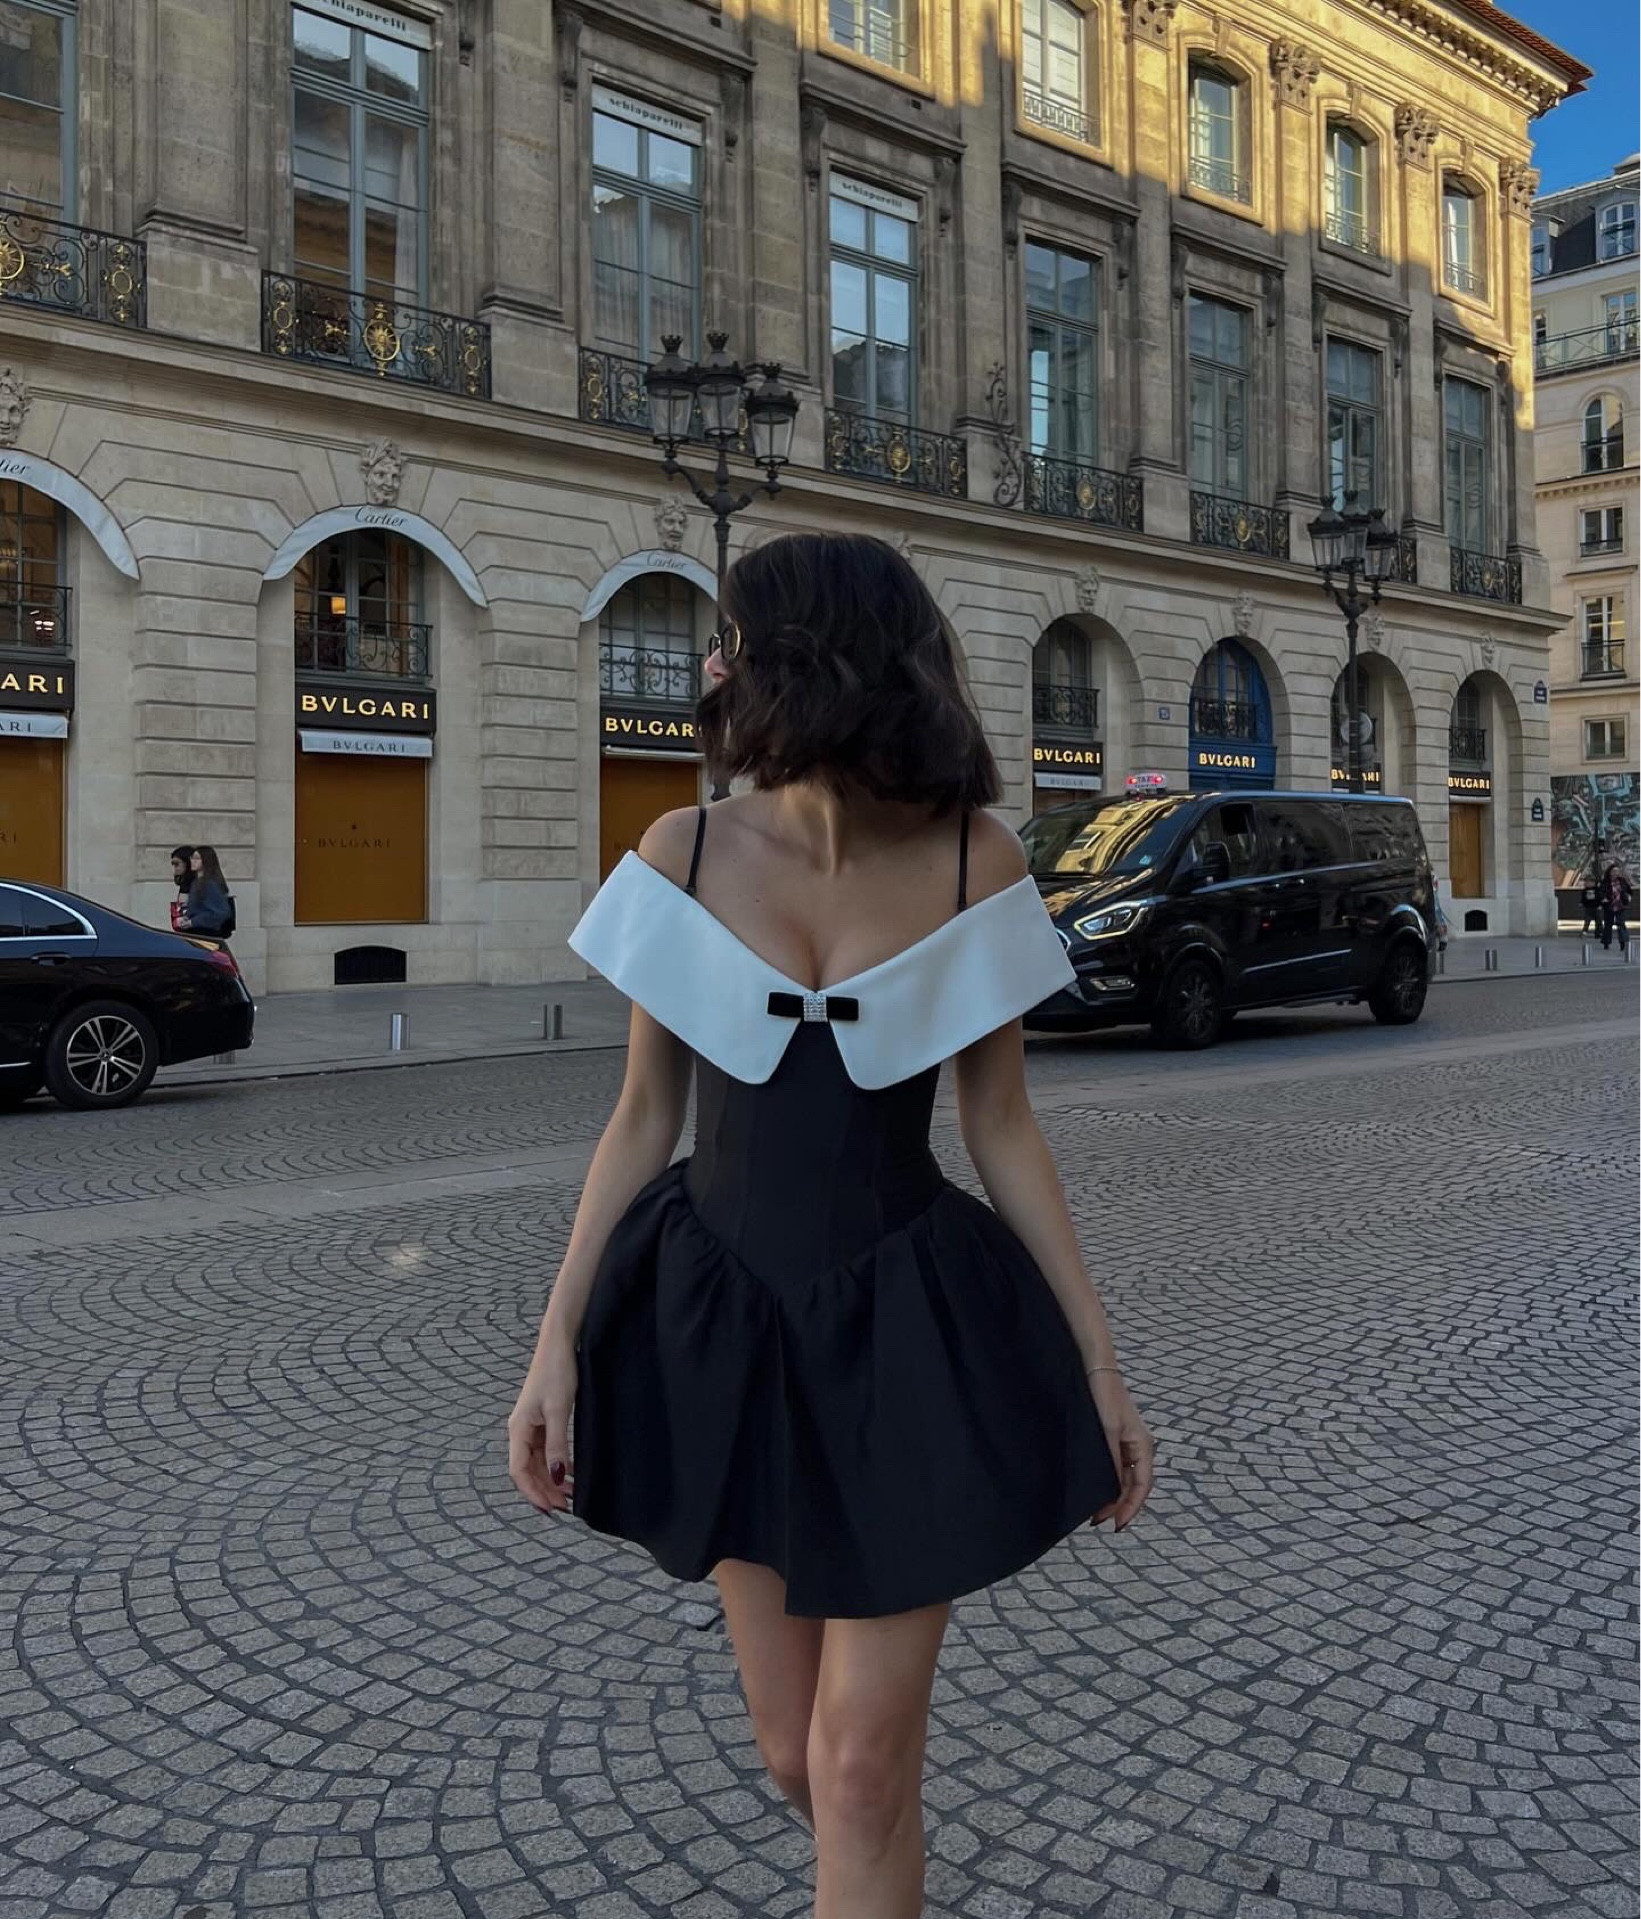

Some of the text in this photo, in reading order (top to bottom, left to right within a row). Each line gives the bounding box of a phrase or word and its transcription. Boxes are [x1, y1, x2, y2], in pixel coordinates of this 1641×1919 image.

[322, 0, 406, 31] hiaparelli
[610, 98, 683, 130] schiaparelli
[355, 506, 408, 527] Cartier
[646, 551, 688, 570] Cartier
[302, 695, 428, 719] BVLGARI
[605, 717, 701, 738] BVLGAR
[333, 740, 405, 752] BVLGARI
[1033, 747, 1100, 764] BVLGARI
[1199, 753, 1256, 769] BVLGARI
[1448, 777, 1490, 790] BVLGARI
[318, 838, 391, 848] BVLGARI
